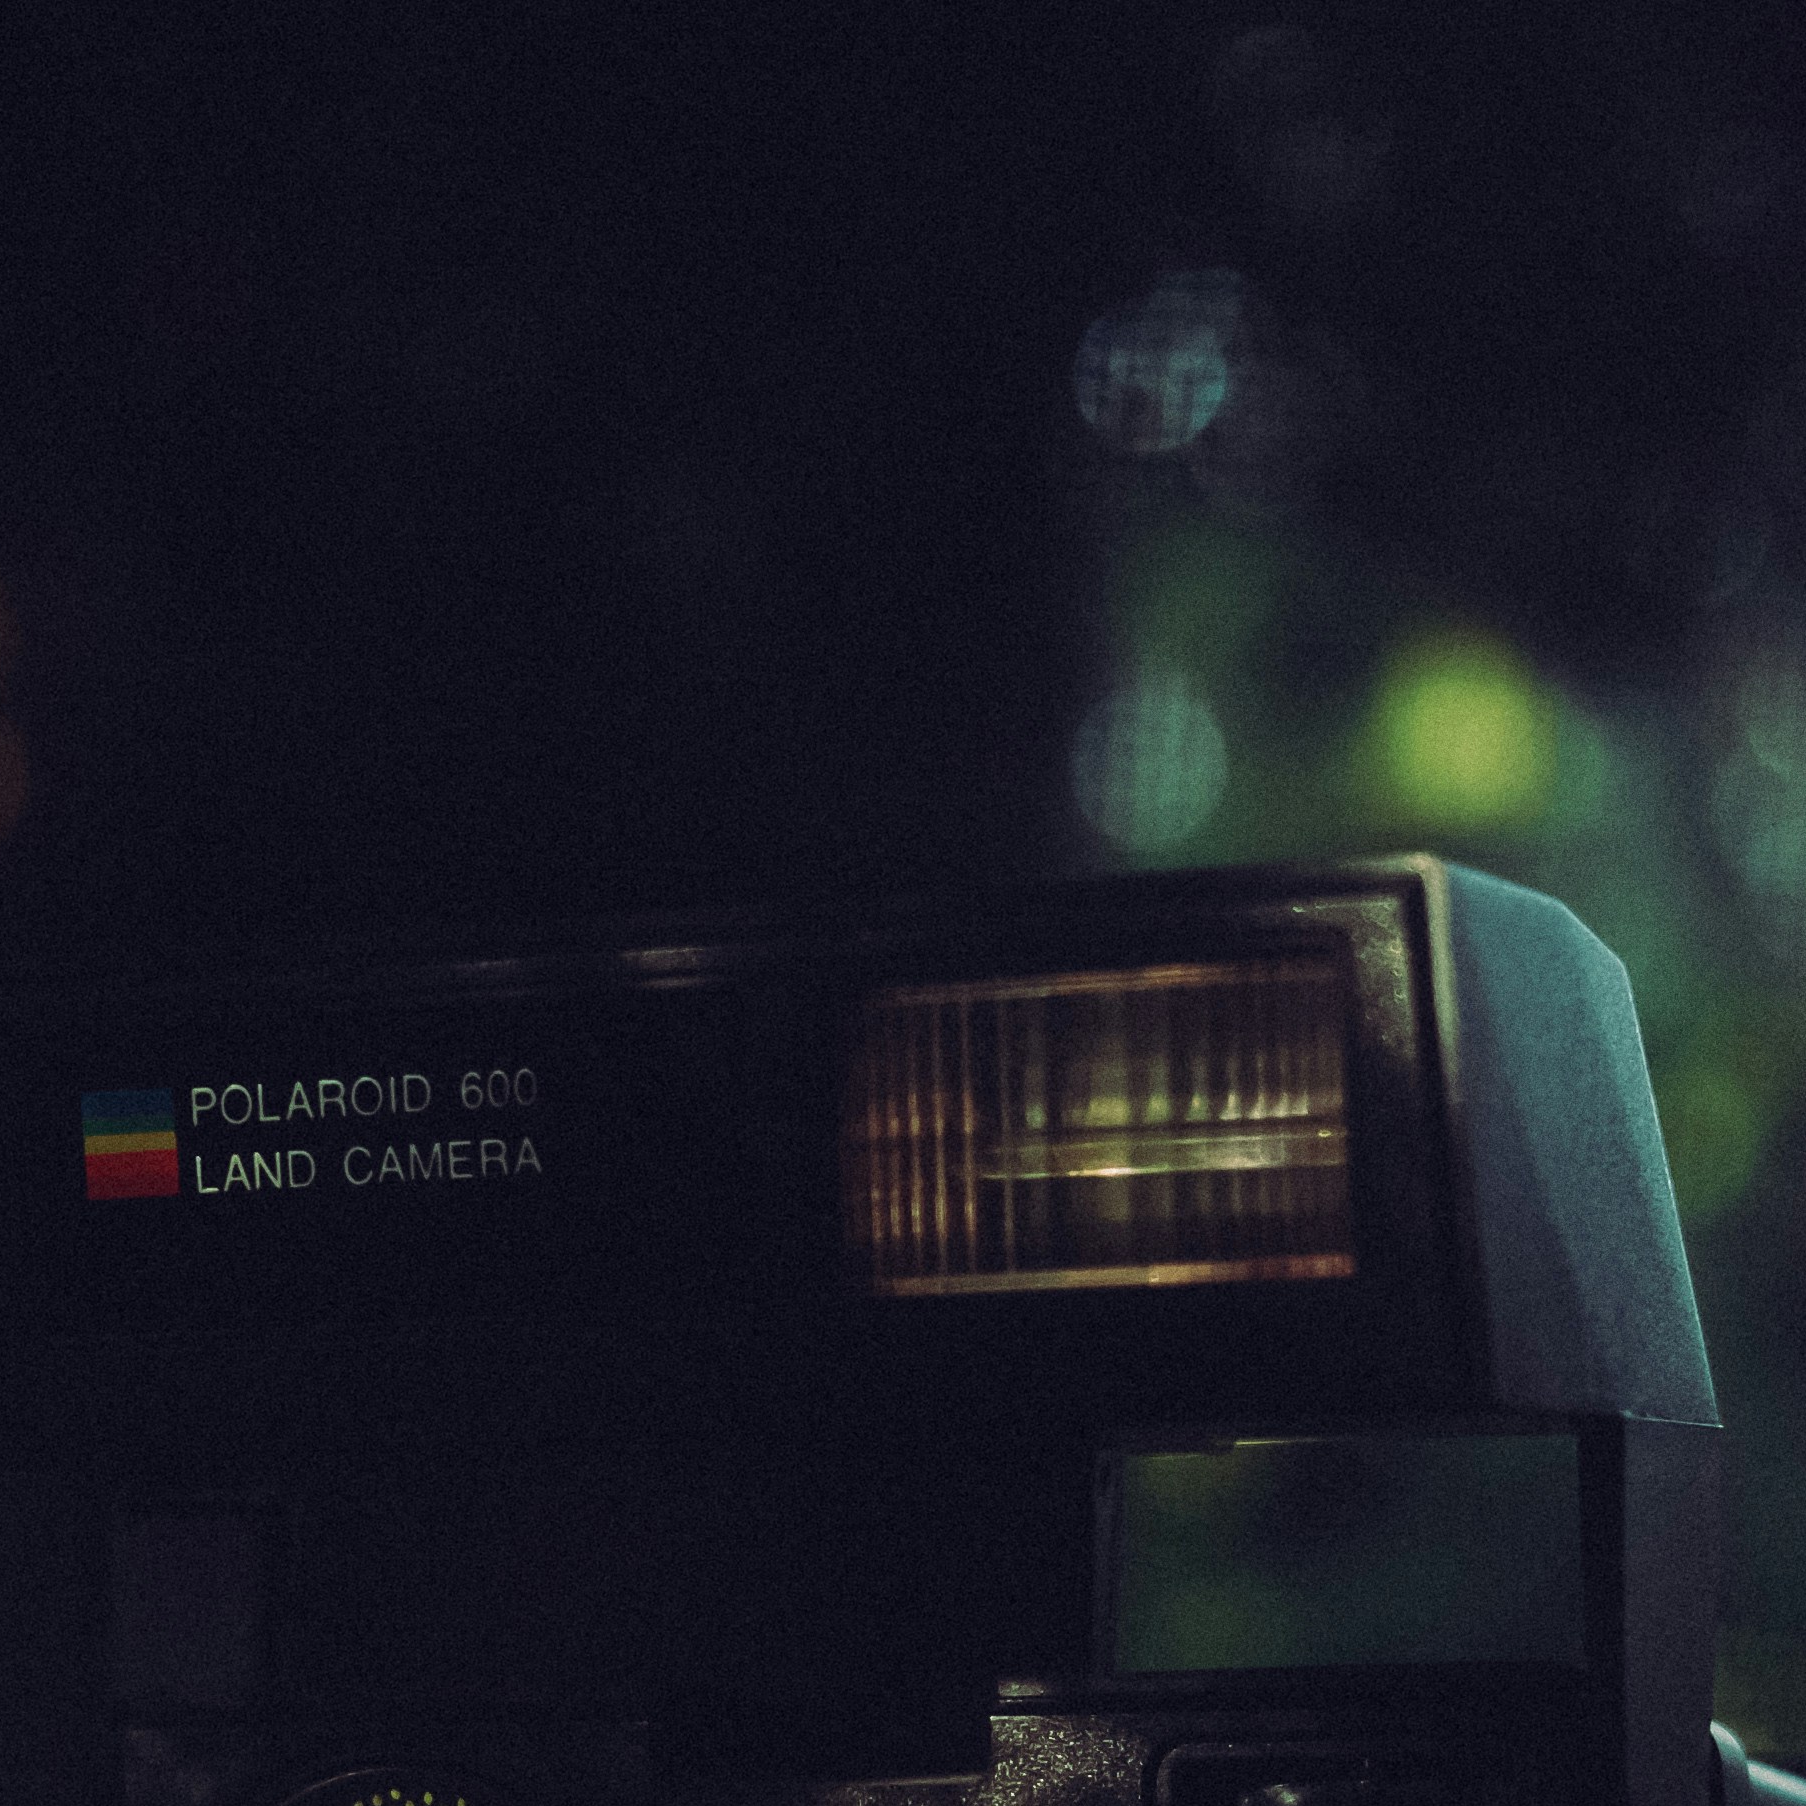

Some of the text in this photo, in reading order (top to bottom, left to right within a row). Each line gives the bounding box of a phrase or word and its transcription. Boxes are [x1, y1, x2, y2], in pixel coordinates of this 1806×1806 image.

[192, 1068, 538, 1126] POLAROID 600
[195, 1137, 543, 1194] LAND CAMERA
